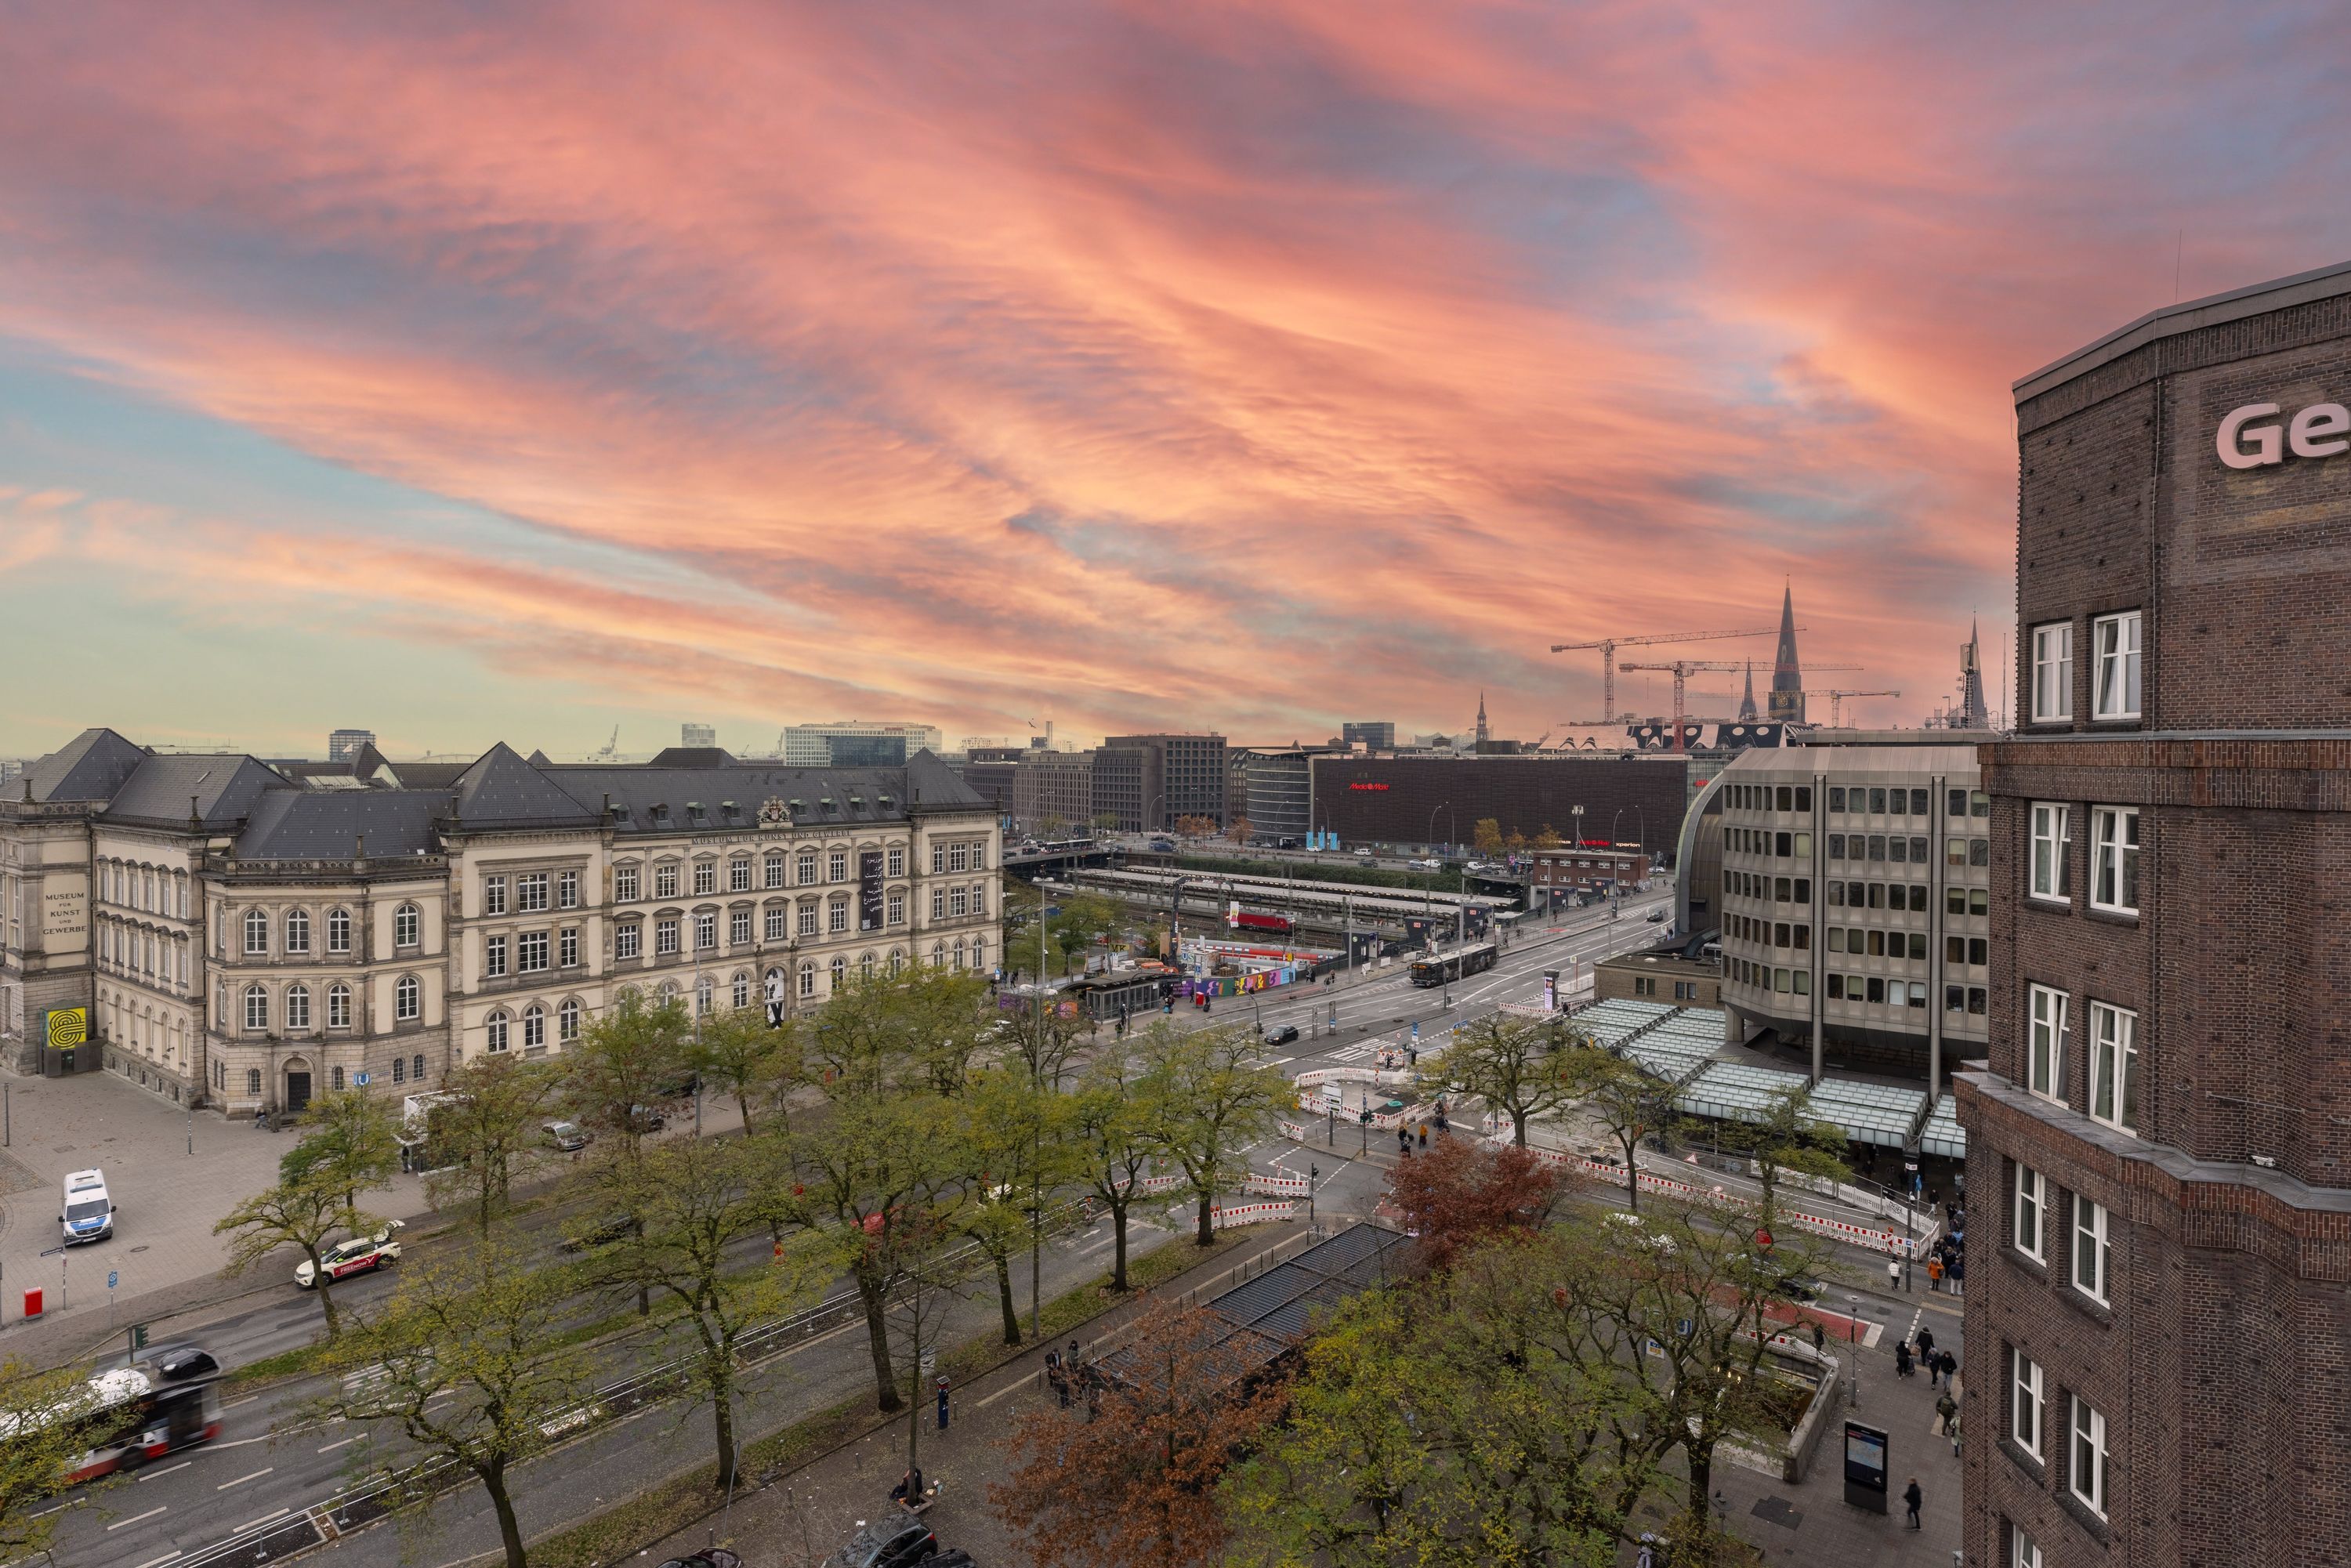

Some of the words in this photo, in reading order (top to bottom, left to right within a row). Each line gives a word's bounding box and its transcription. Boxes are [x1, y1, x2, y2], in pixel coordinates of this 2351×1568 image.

[2216, 403, 2351, 469] Ge
[693, 836, 733, 845] MUSEUM
[759, 832, 788, 842] KUNST
[792, 831, 810, 840] UND
[813, 830, 851, 838] GEWERBE
[50, 909, 81, 918] KUNST
[43, 925, 87, 934] GEWERBE
[340, 1262, 368, 1273] FREENOW
